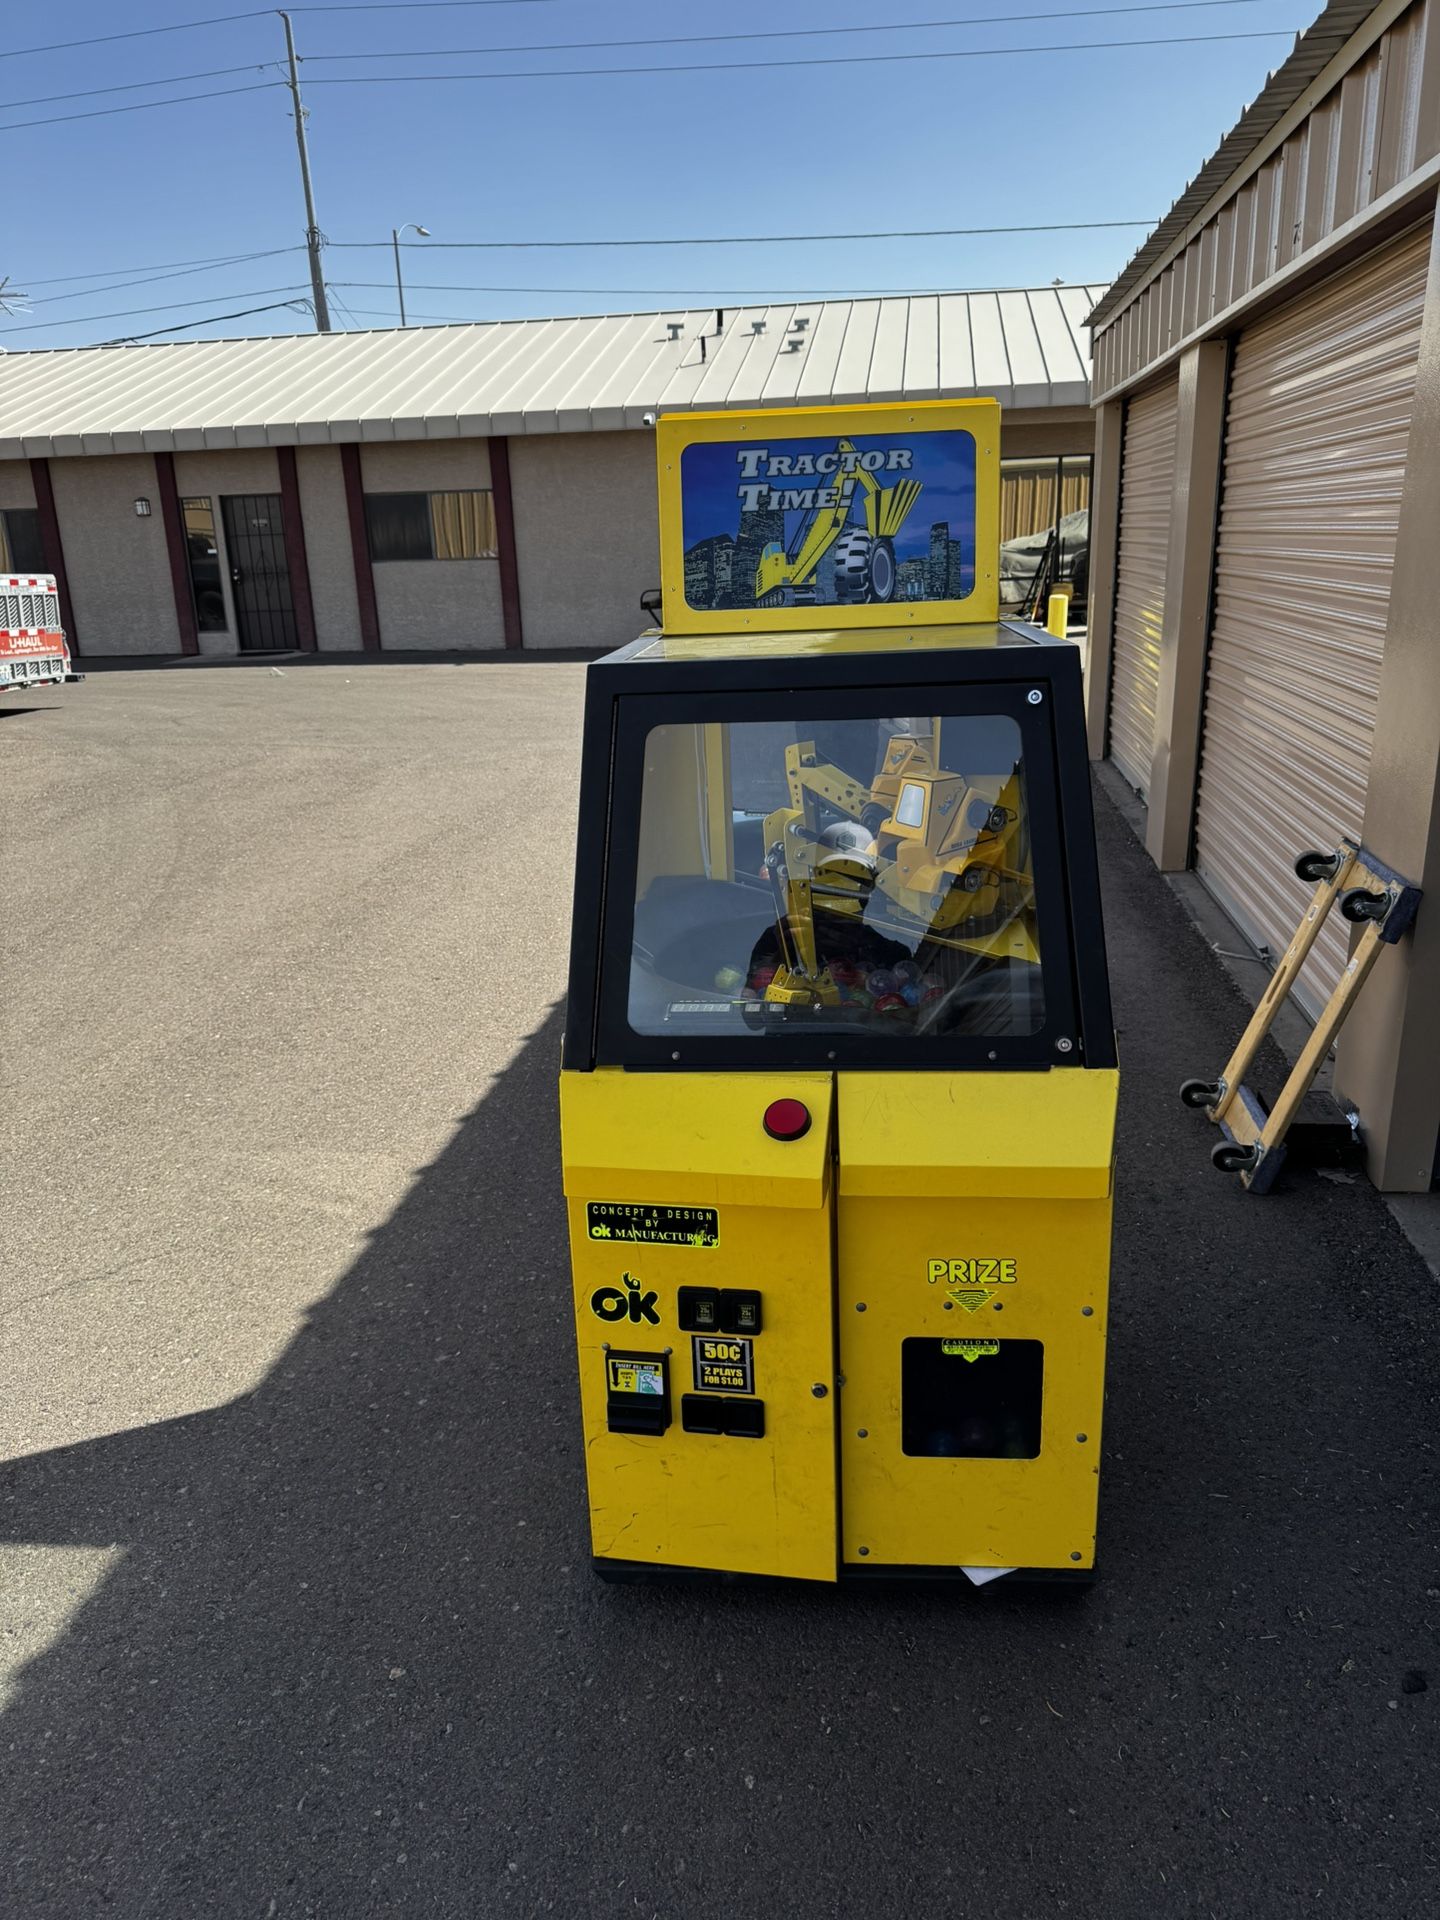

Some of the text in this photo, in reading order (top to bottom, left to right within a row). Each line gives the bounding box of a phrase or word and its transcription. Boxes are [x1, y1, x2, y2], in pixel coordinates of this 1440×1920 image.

[736, 448, 913, 478] TRACTOR
[737, 478, 855, 512] TIME!
[9, 636, 43, 649] U-HAUL
[592, 1205, 713, 1221] CONCEPT & DESIGN
[645, 1219, 659, 1228] BY
[928, 1258, 1017, 1284] PRIZE
[704, 1342, 741, 1361] 50¢
[704, 1366, 743, 1377] 2 PLAYS
[704, 1376, 744, 1386] FOR $1.00
